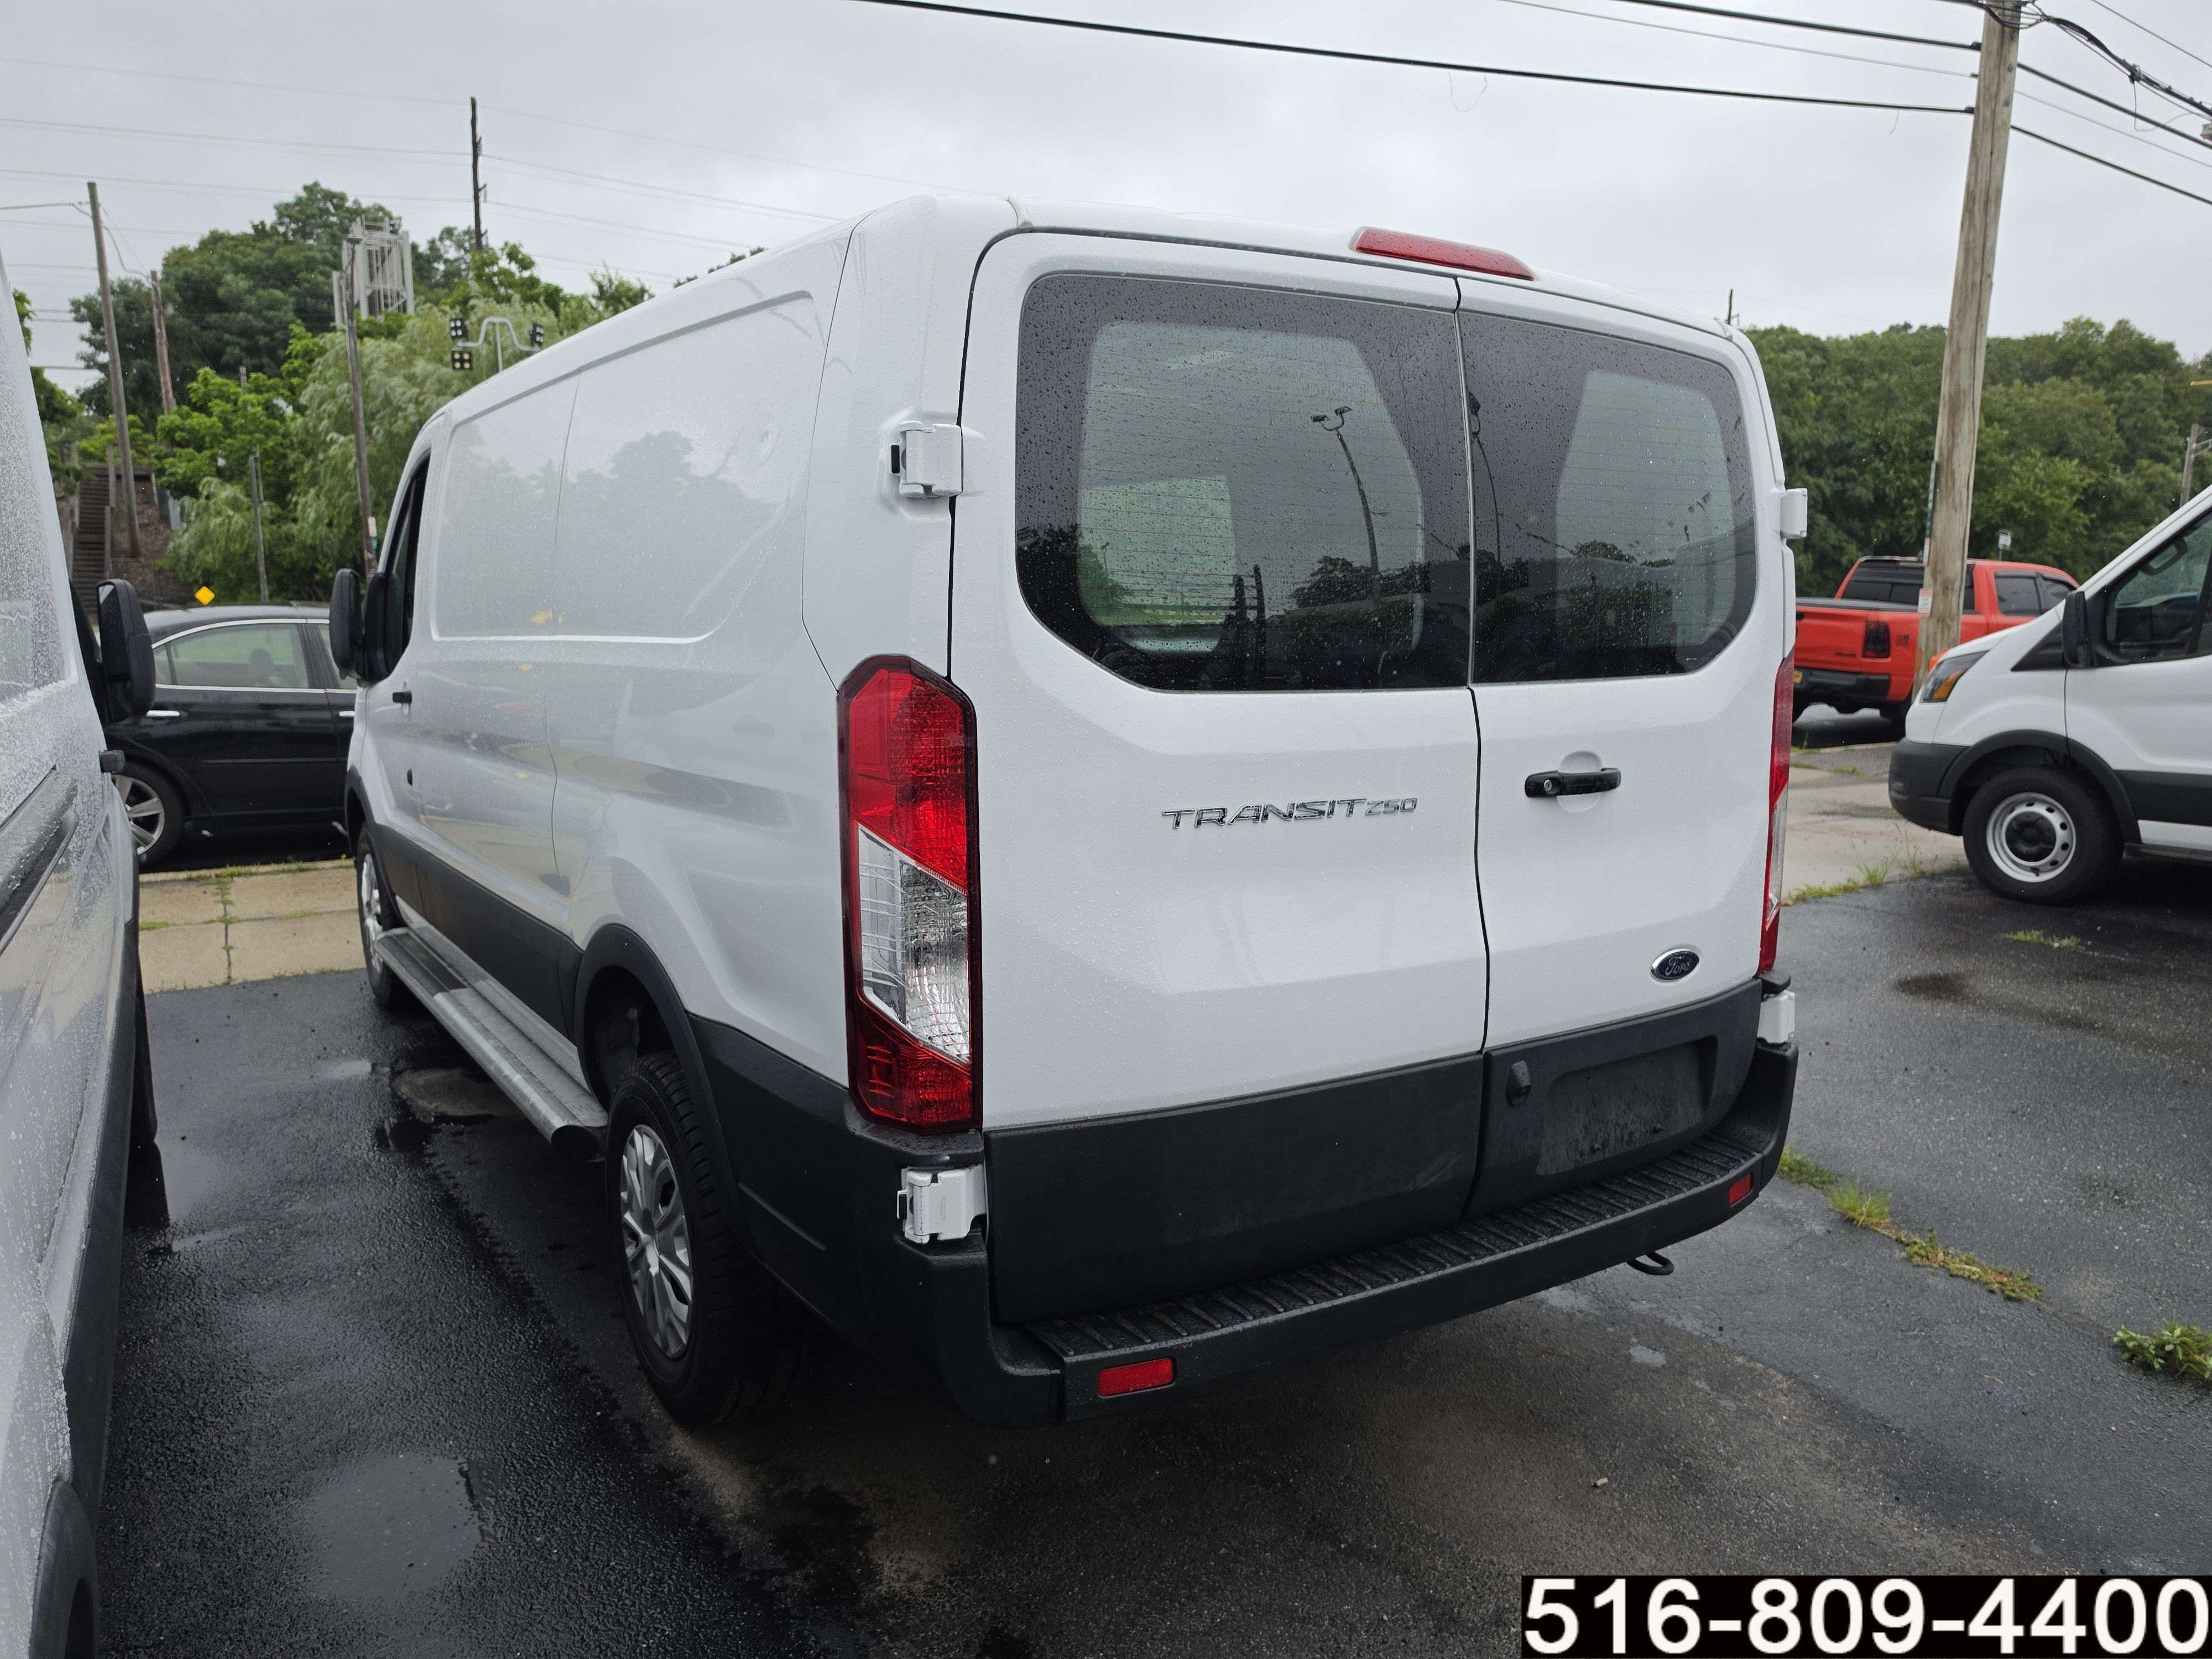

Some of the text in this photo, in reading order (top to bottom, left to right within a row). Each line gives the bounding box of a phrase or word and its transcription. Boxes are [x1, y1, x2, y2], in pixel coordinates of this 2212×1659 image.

[1161, 798, 1418, 829] TRANSIT 250
[1665, 955, 1693, 976] Ford
